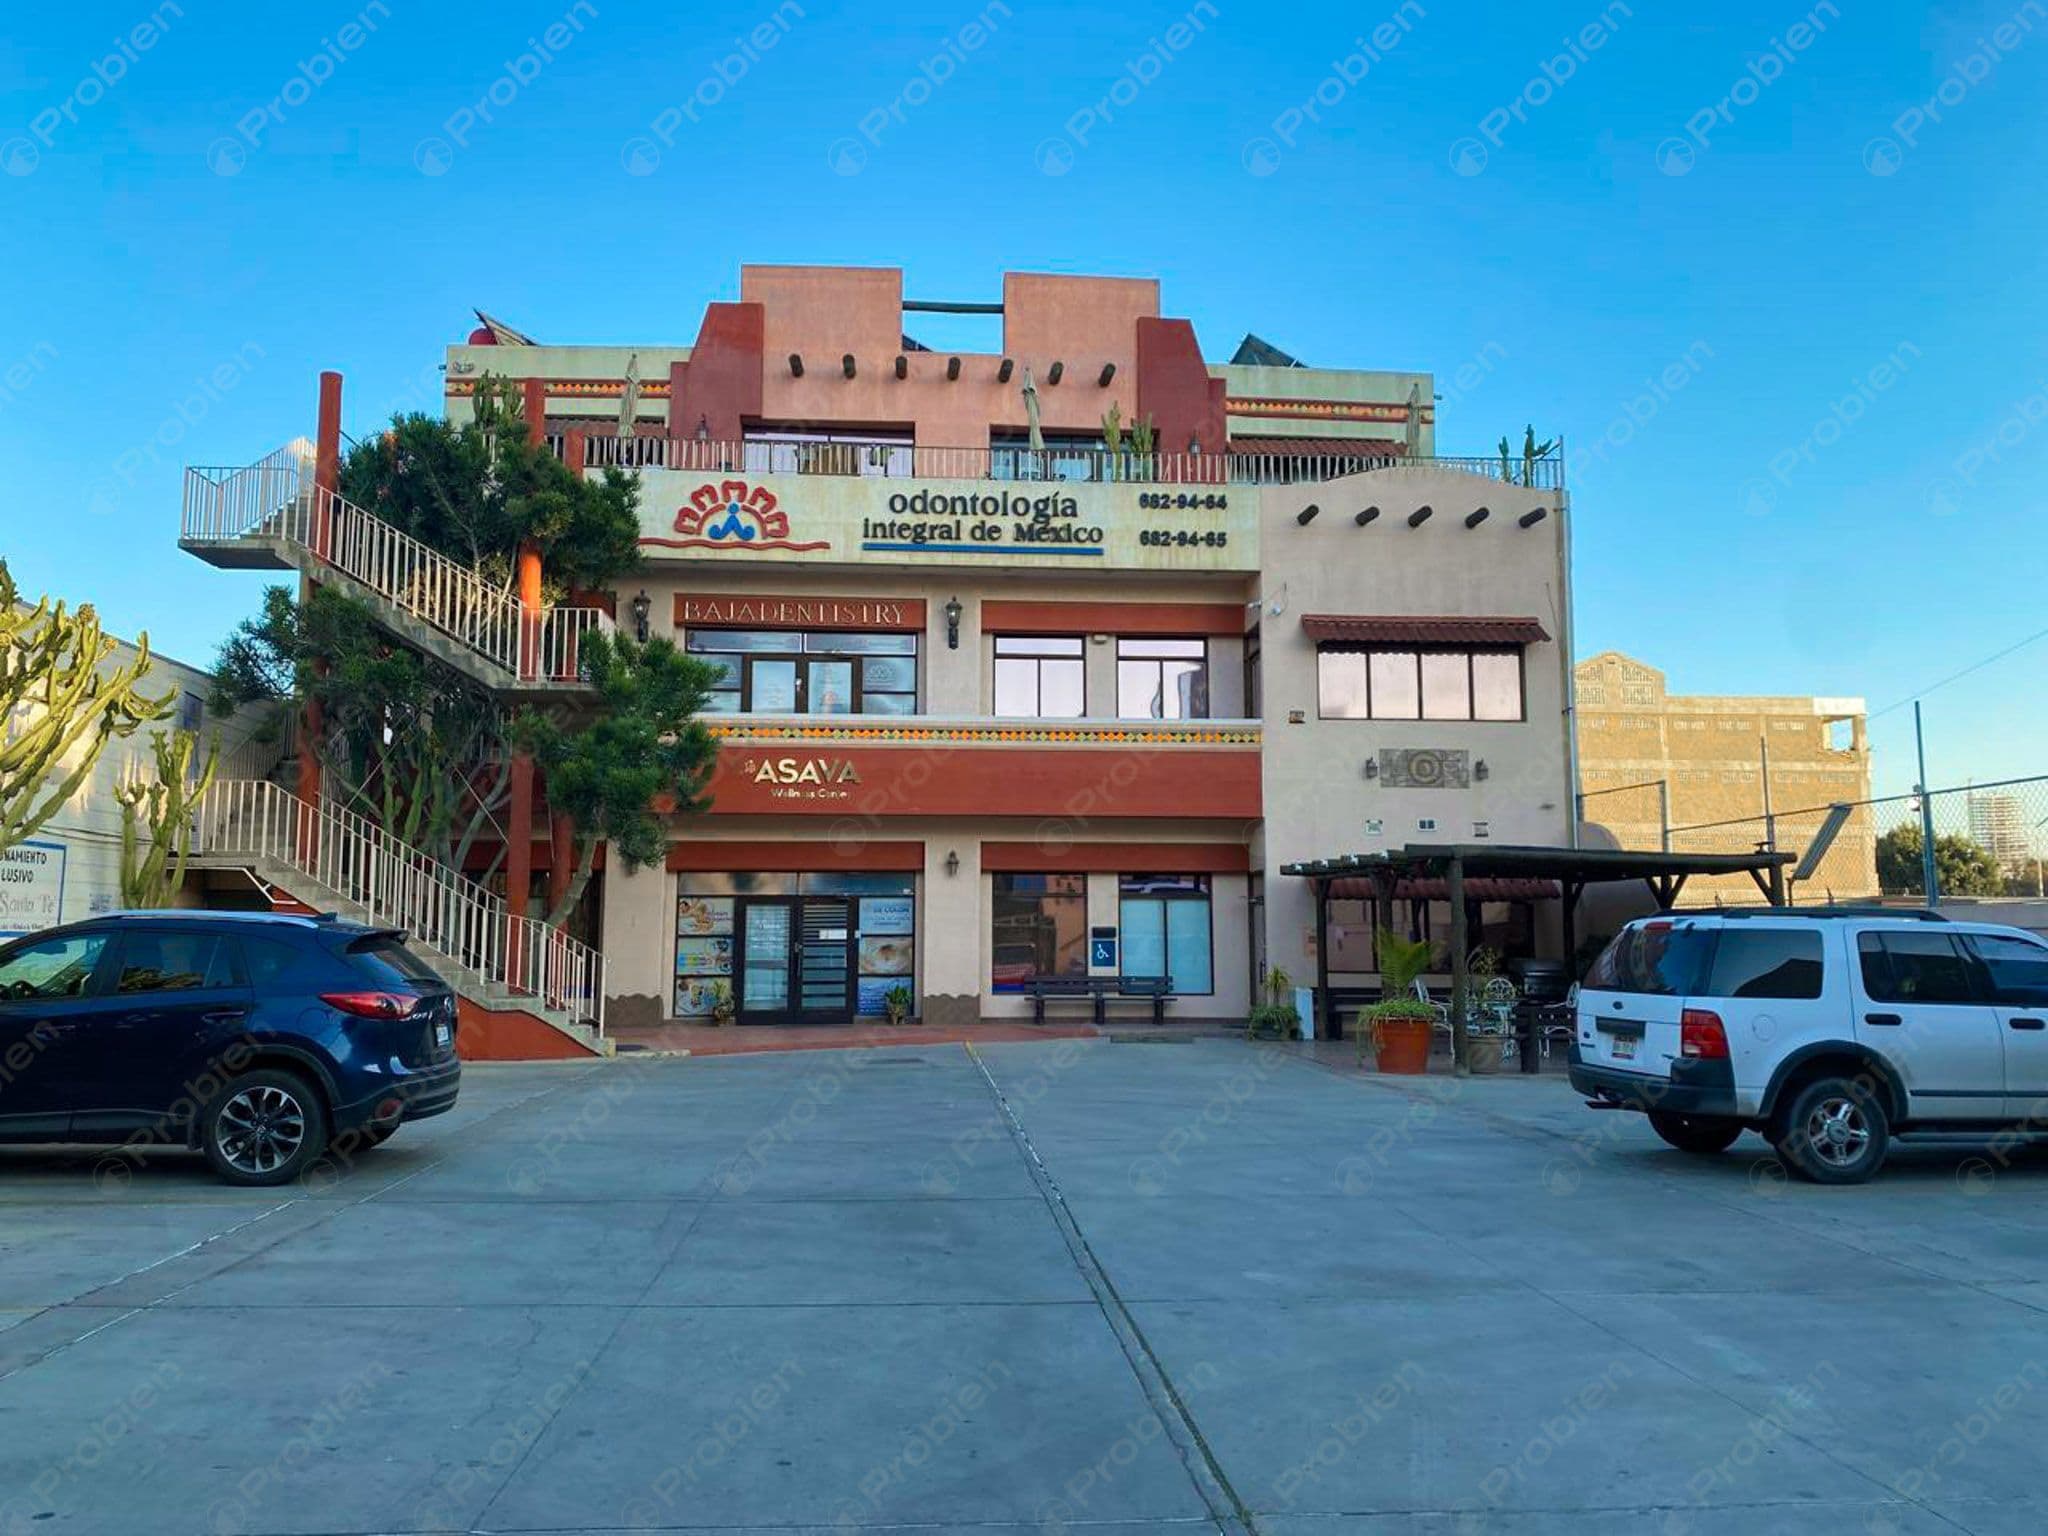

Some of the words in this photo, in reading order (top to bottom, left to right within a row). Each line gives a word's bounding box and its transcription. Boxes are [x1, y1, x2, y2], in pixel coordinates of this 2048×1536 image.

[889, 489, 1078, 524] odontología
[862, 518, 961, 544] integral
[972, 520, 1002, 541] de
[754, 758, 862, 784] ASAVA
